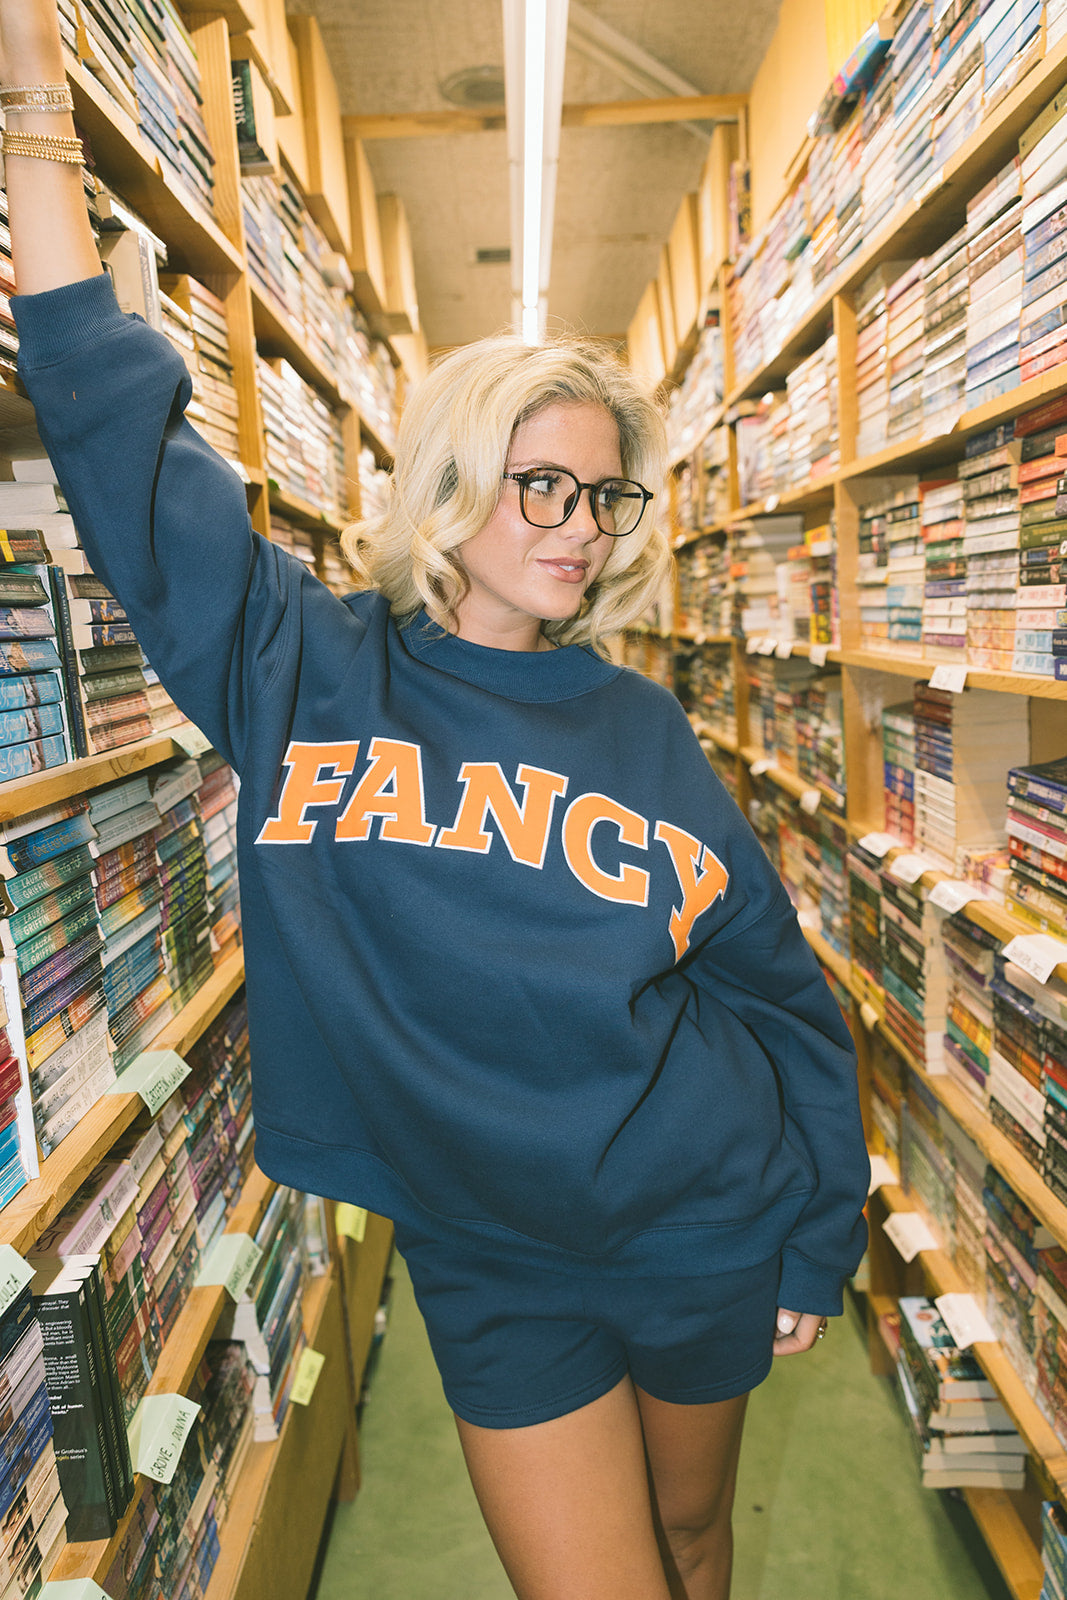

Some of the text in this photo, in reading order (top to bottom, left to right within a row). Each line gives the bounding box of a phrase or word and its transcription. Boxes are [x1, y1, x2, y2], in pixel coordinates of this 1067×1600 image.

[254, 737, 730, 965] FANCY
[20, 870, 43, 888] LAURA
[23, 880, 50, 899] GRIFFIN
[23, 914, 50, 936] GRIFFIN
[30, 934, 52, 953] LAURA
[30, 943, 56, 964] GRIFFIN
[87, 1342, 97, 1386] ADRIAN
